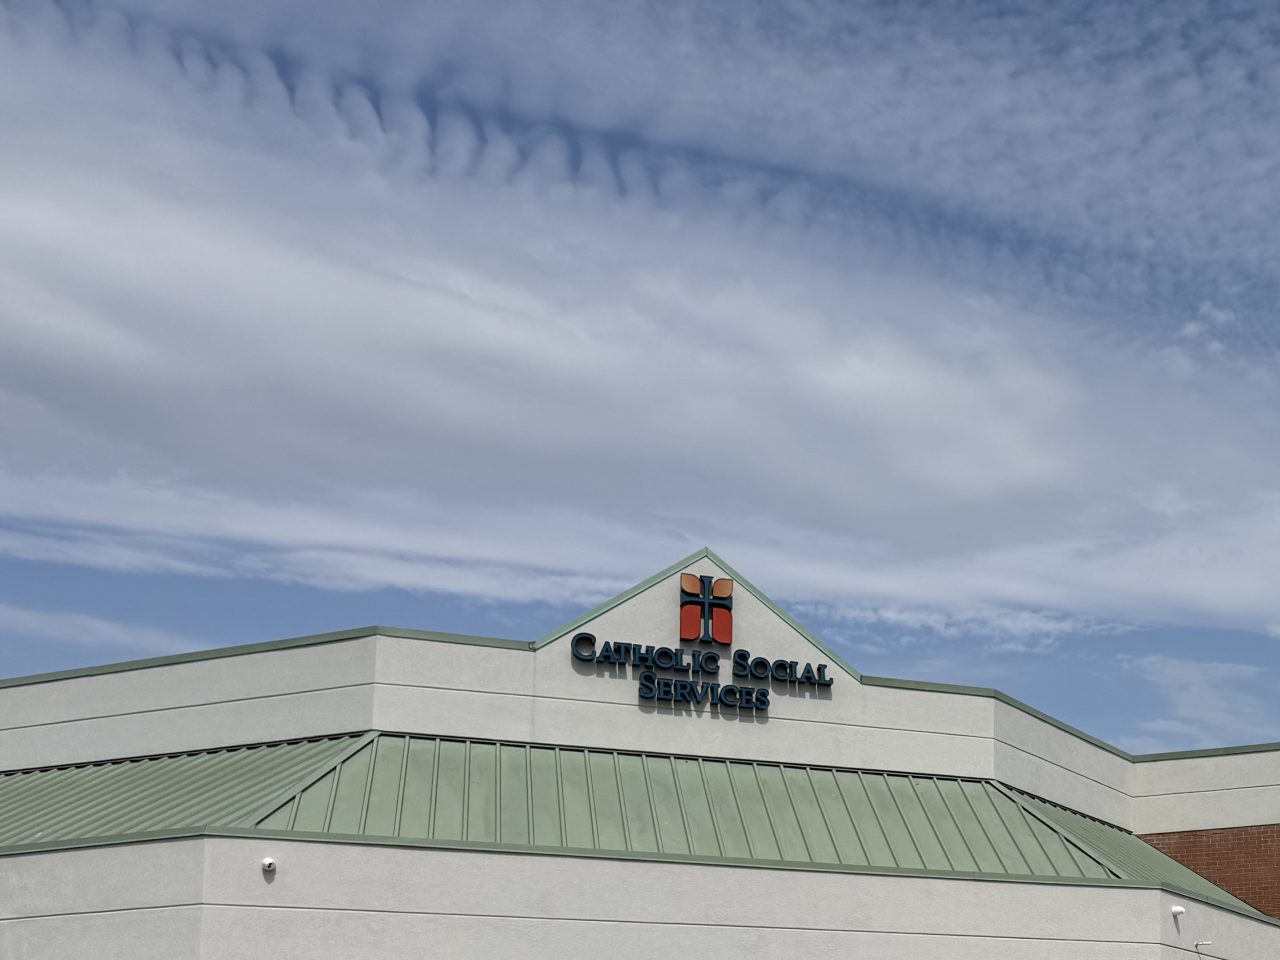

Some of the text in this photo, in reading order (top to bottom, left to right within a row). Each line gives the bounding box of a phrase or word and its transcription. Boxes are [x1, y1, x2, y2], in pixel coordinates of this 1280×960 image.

[571, 633, 833, 686] CATHOLIC SOCIAL
[639, 671, 769, 710] SERVICES
